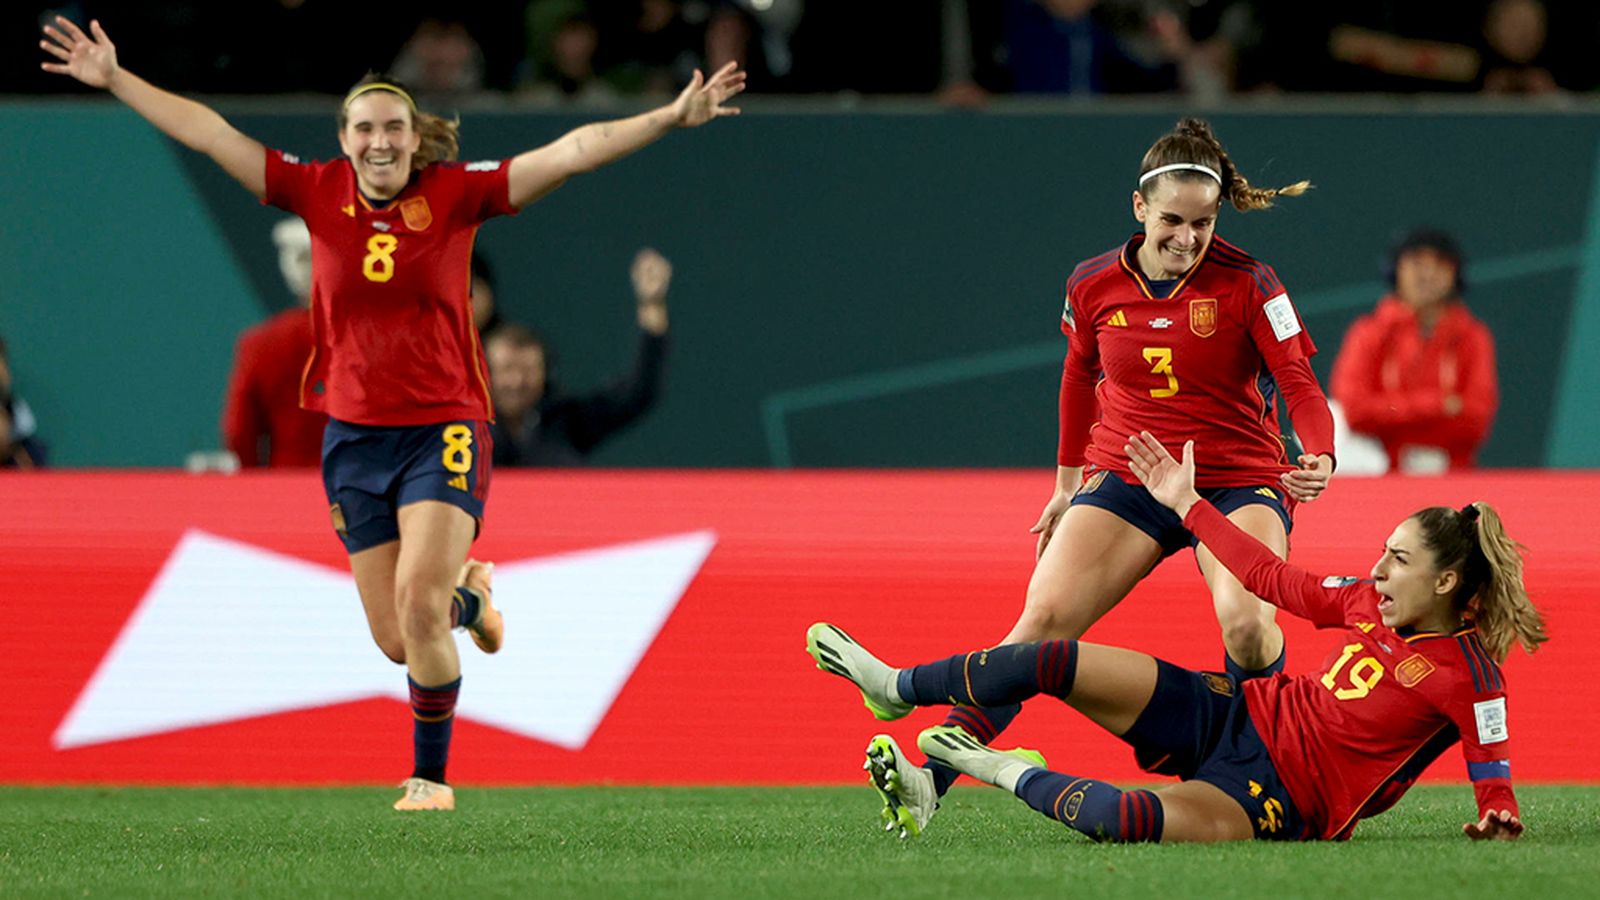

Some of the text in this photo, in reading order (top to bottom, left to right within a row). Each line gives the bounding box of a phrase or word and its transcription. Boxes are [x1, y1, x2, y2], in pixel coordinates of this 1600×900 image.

[363, 233, 398, 282] 8
[1142, 347, 1179, 398] 3
[442, 424, 473, 473] 8
[1320, 642, 1384, 700] 19
